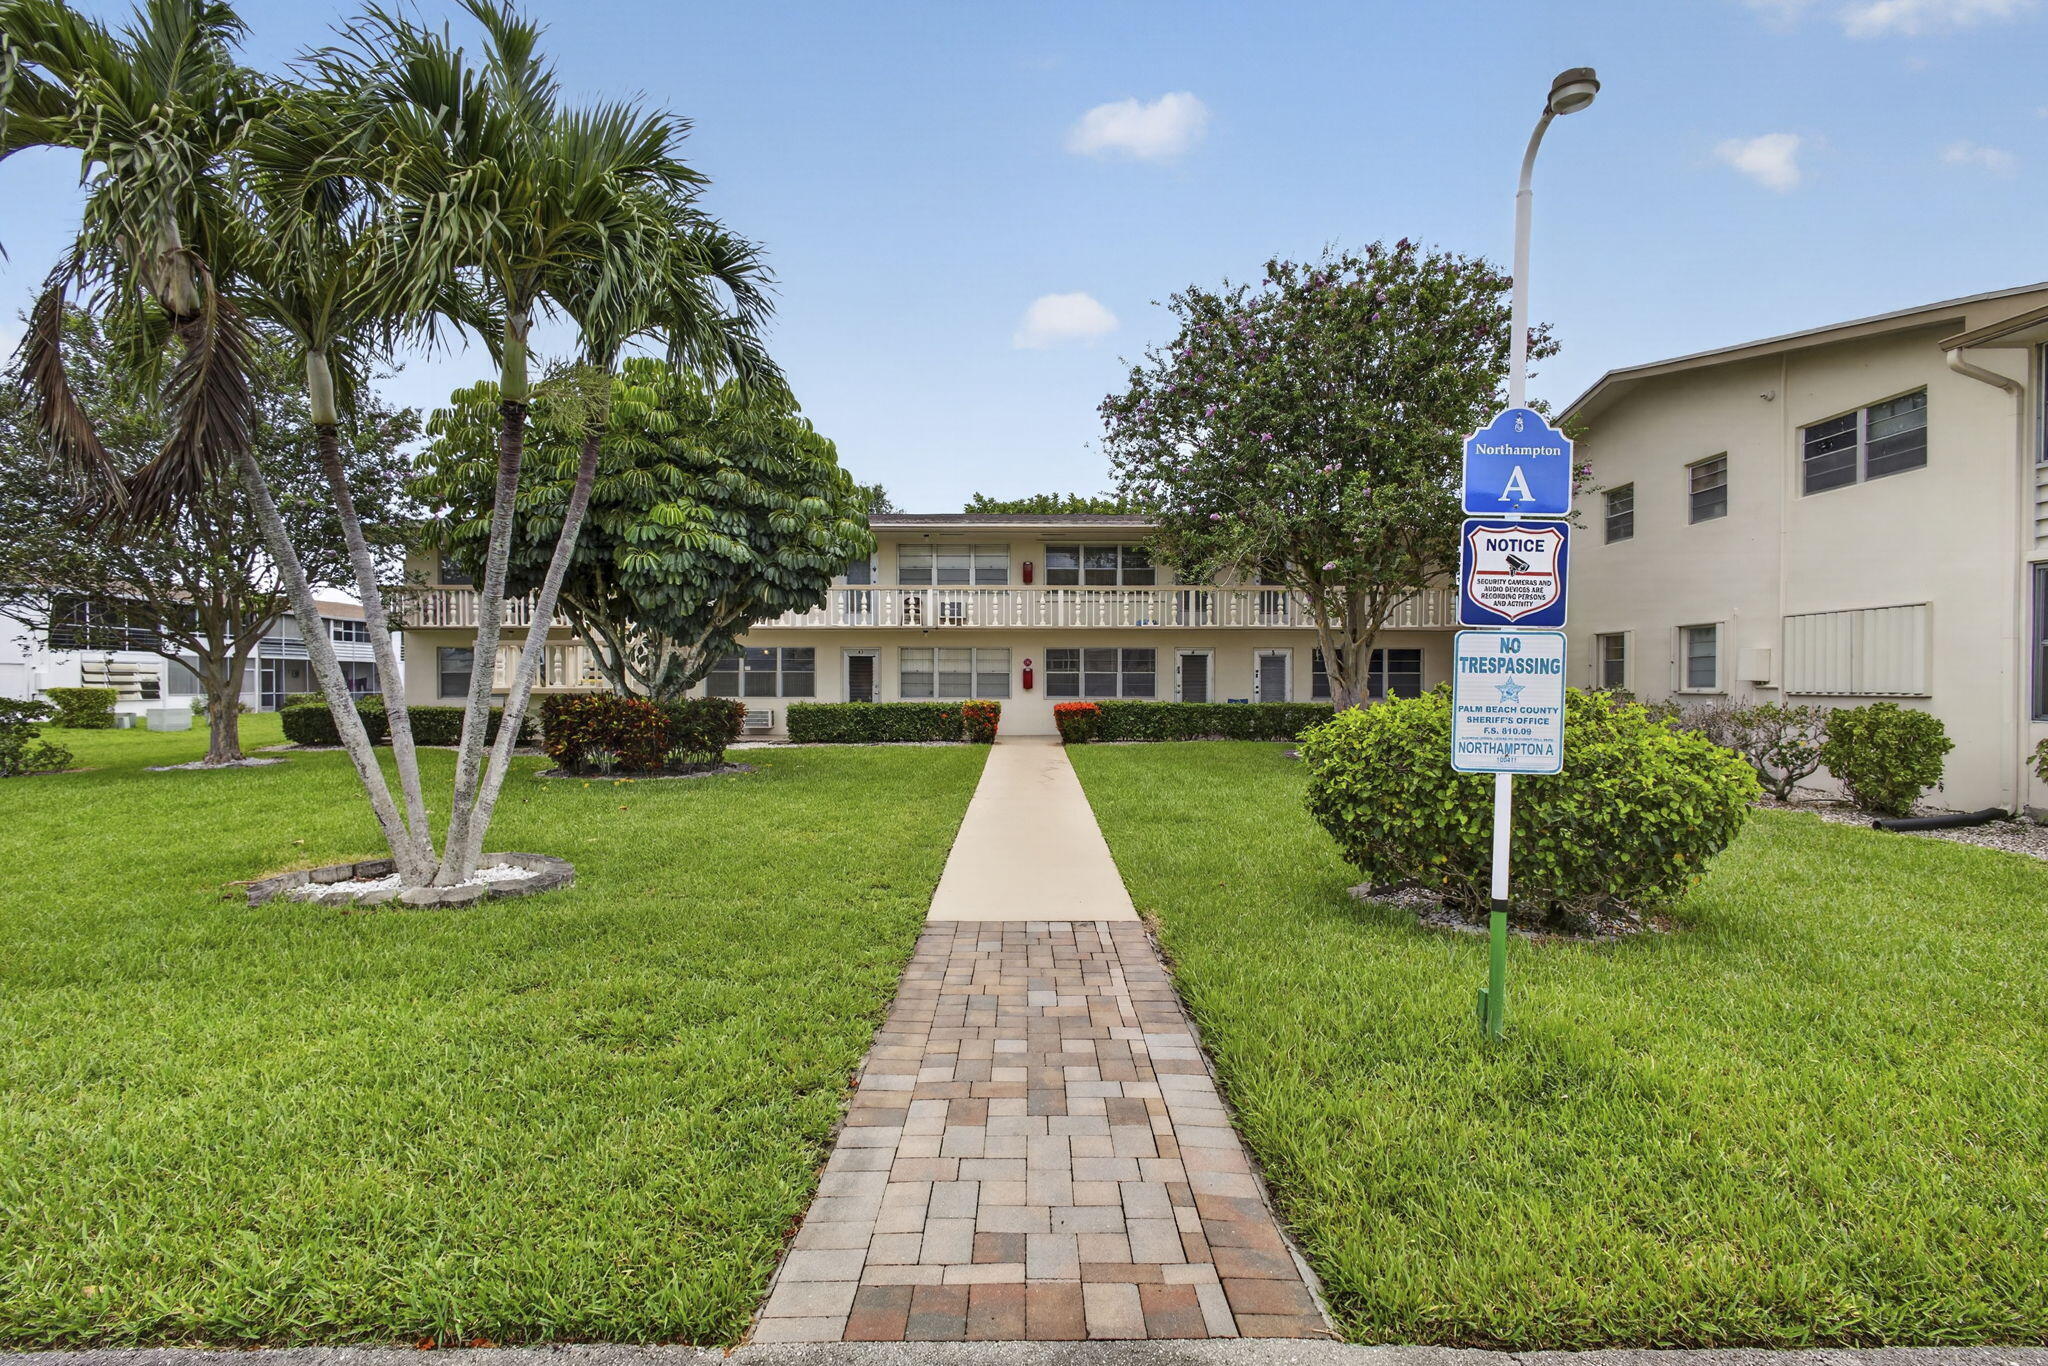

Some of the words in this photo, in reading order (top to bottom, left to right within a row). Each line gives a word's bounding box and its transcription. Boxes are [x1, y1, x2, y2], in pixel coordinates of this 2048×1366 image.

[1475, 444, 1561, 459] Northampton
[1498, 465, 1536, 502] A
[1486, 538, 1545, 553] NOTICE
[1508, 579, 1537, 587] CAMERAS
[1480, 592, 1516, 600] RECORDING
[1500, 637, 1521, 654] NO
[1459, 656, 1561, 675] TRESPASSING
[1520, 706, 1559, 714] COUNTY
[1516, 717, 1550, 725] OFFICE
[1458, 742, 1544, 756] NORTHAMPTON
[1546, 744, 1554, 756] A
